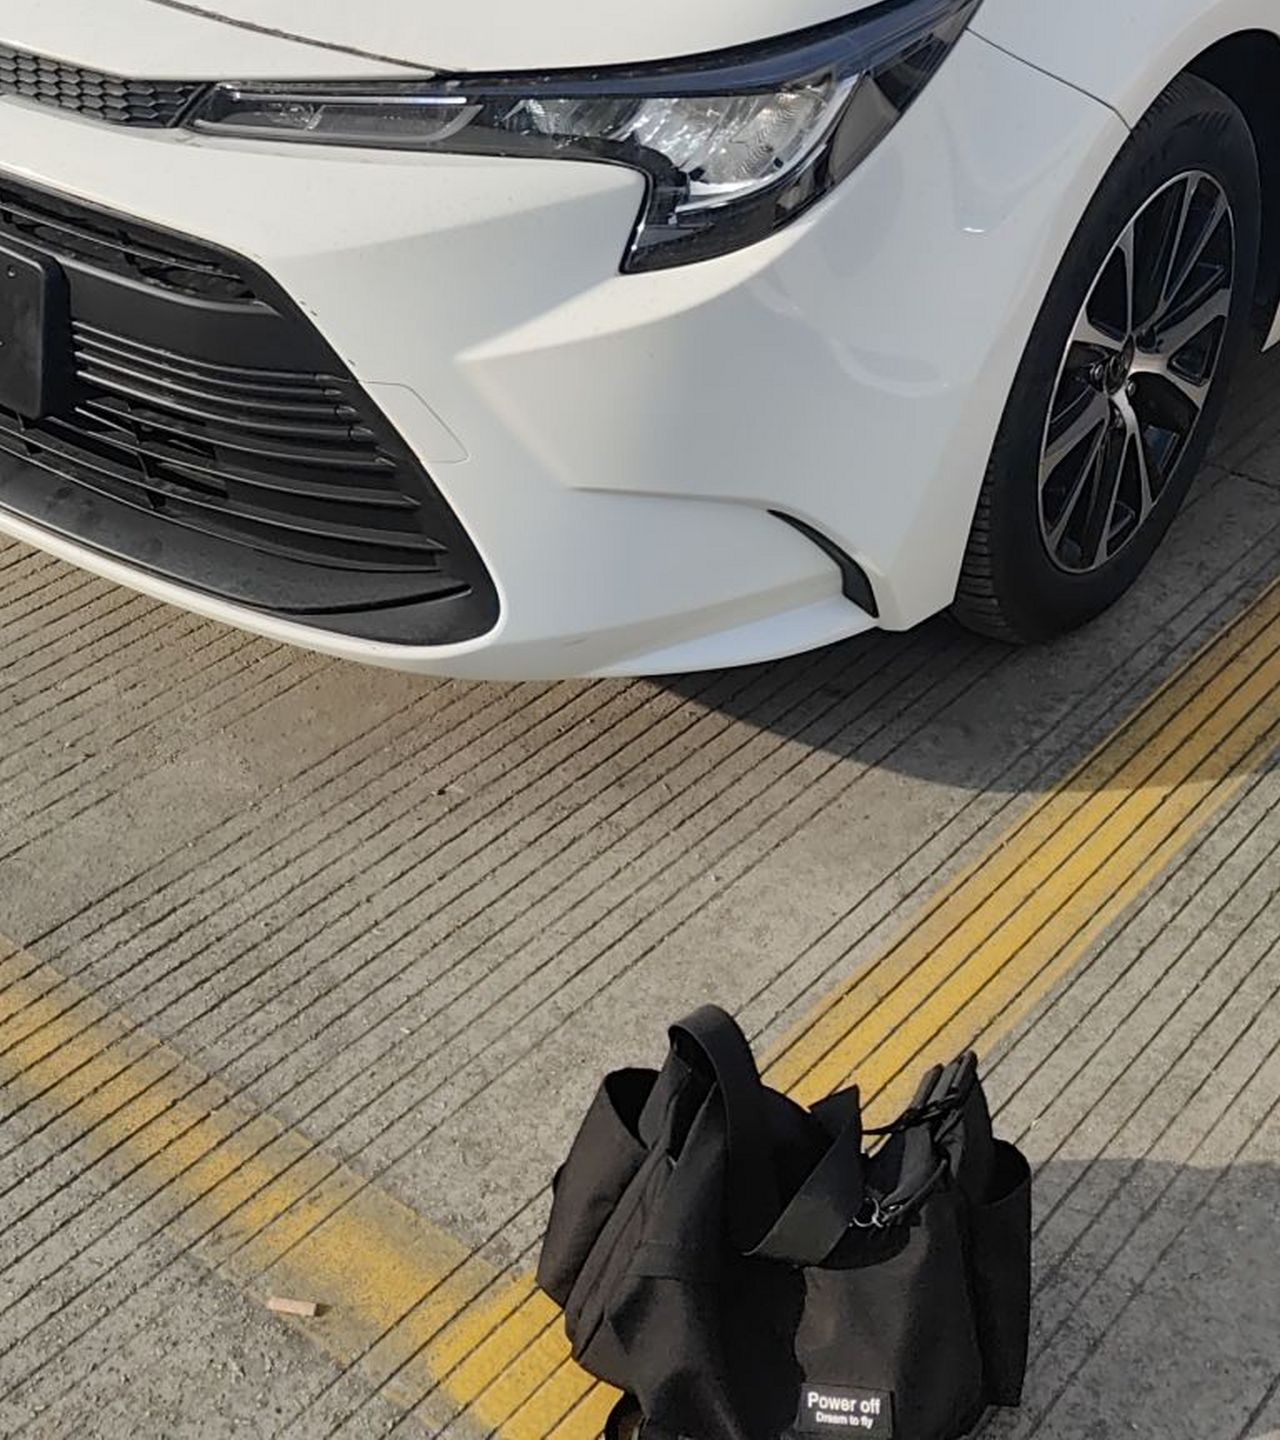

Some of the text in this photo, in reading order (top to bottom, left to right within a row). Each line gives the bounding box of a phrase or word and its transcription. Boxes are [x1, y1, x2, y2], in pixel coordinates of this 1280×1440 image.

[807, 1392, 880, 1413] Power off
[849, 1415, 859, 1426] to
[861, 1415, 874, 1429] fly
